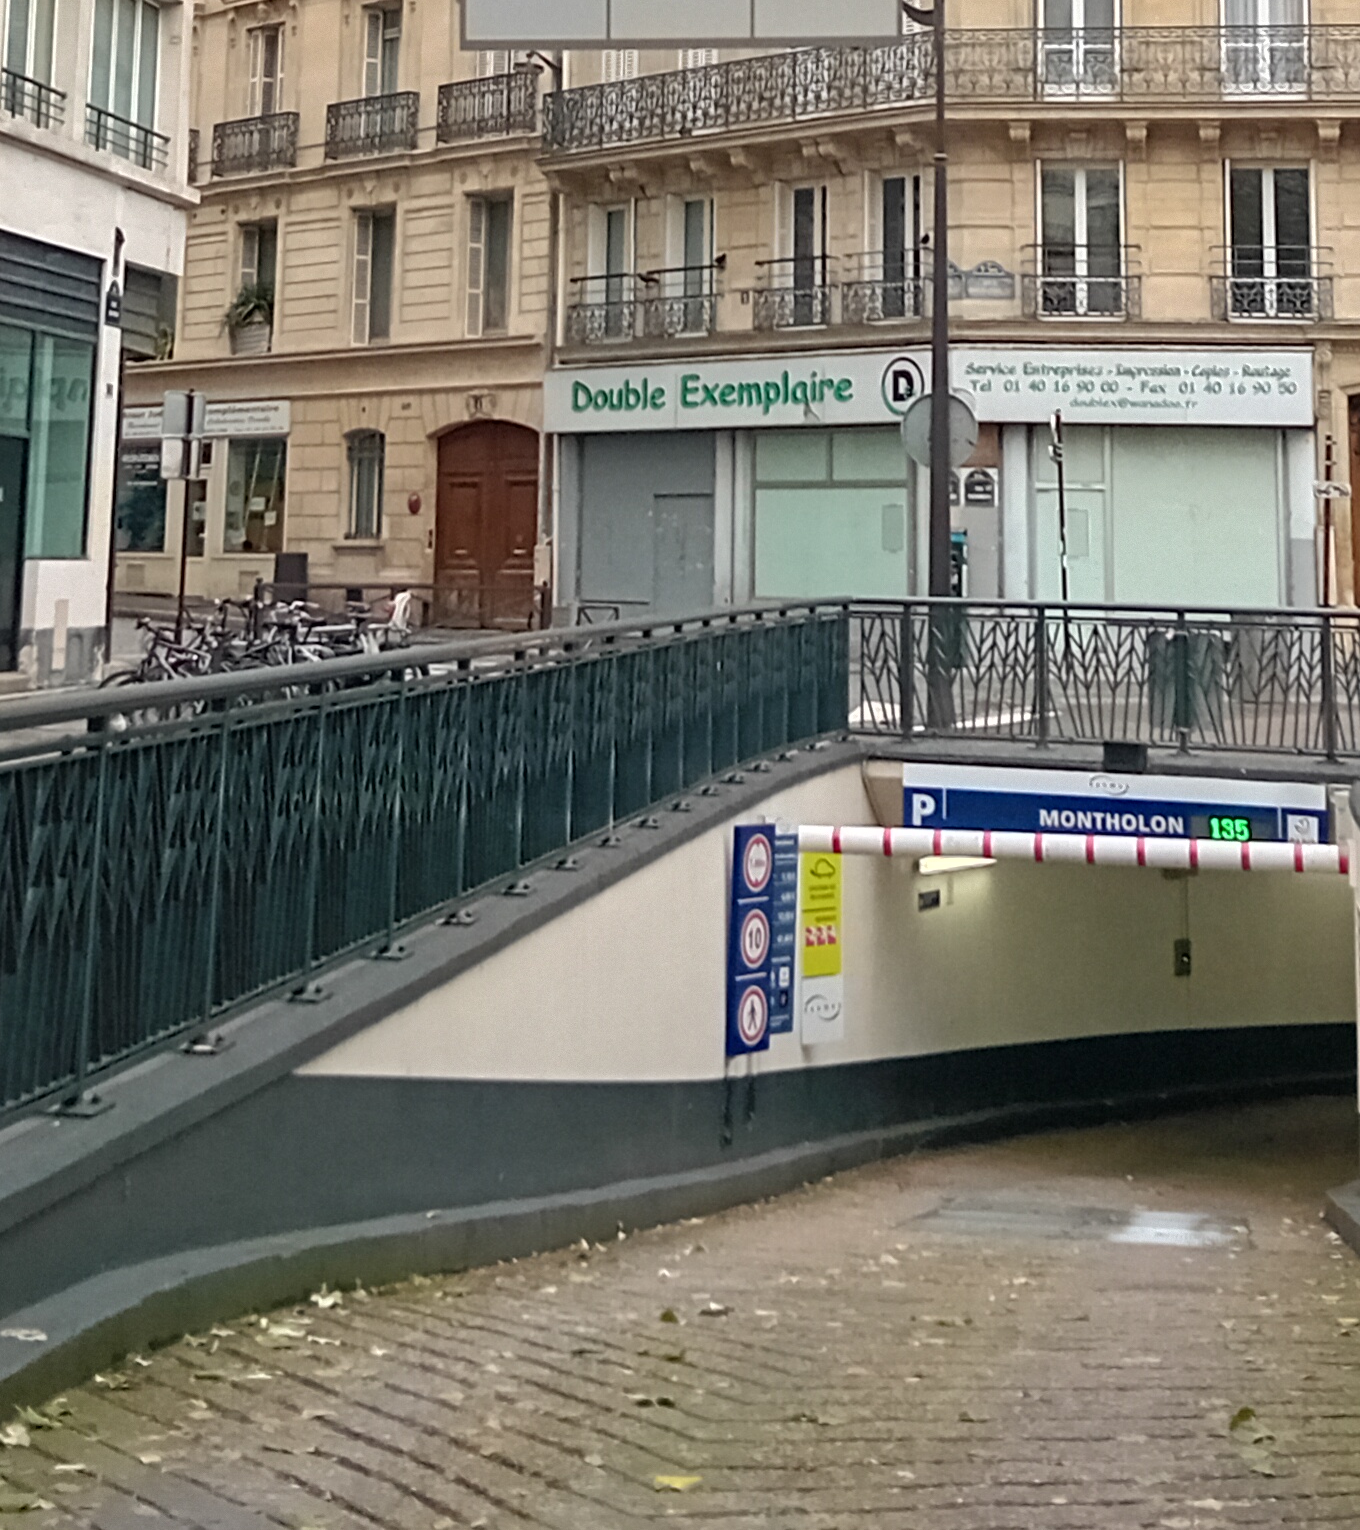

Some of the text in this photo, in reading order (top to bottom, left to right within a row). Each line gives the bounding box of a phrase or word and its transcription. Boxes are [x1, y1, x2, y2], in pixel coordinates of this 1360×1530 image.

[571, 370, 854, 416] Double Exemplaire
[1003, 379, 1021, 393] 01
[1028, 379, 1046, 393] 40
[1053, 379, 1071, 393] 16
[1076, 380, 1095, 393] 90
[1100, 380, 1119, 393] 00
[1140, 380, 1167, 393] Fax
[1178, 380, 1196, 394] 01
[1203, 381, 1222, 394] 40
[1229, 381, 1246, 395] 16
[1252, 381, 1272, 395] 90
[912, 793, 936, 826] P
[1039, 808, 1185, 835] MONTHOLON
[747, 927, 761, 949] 10
